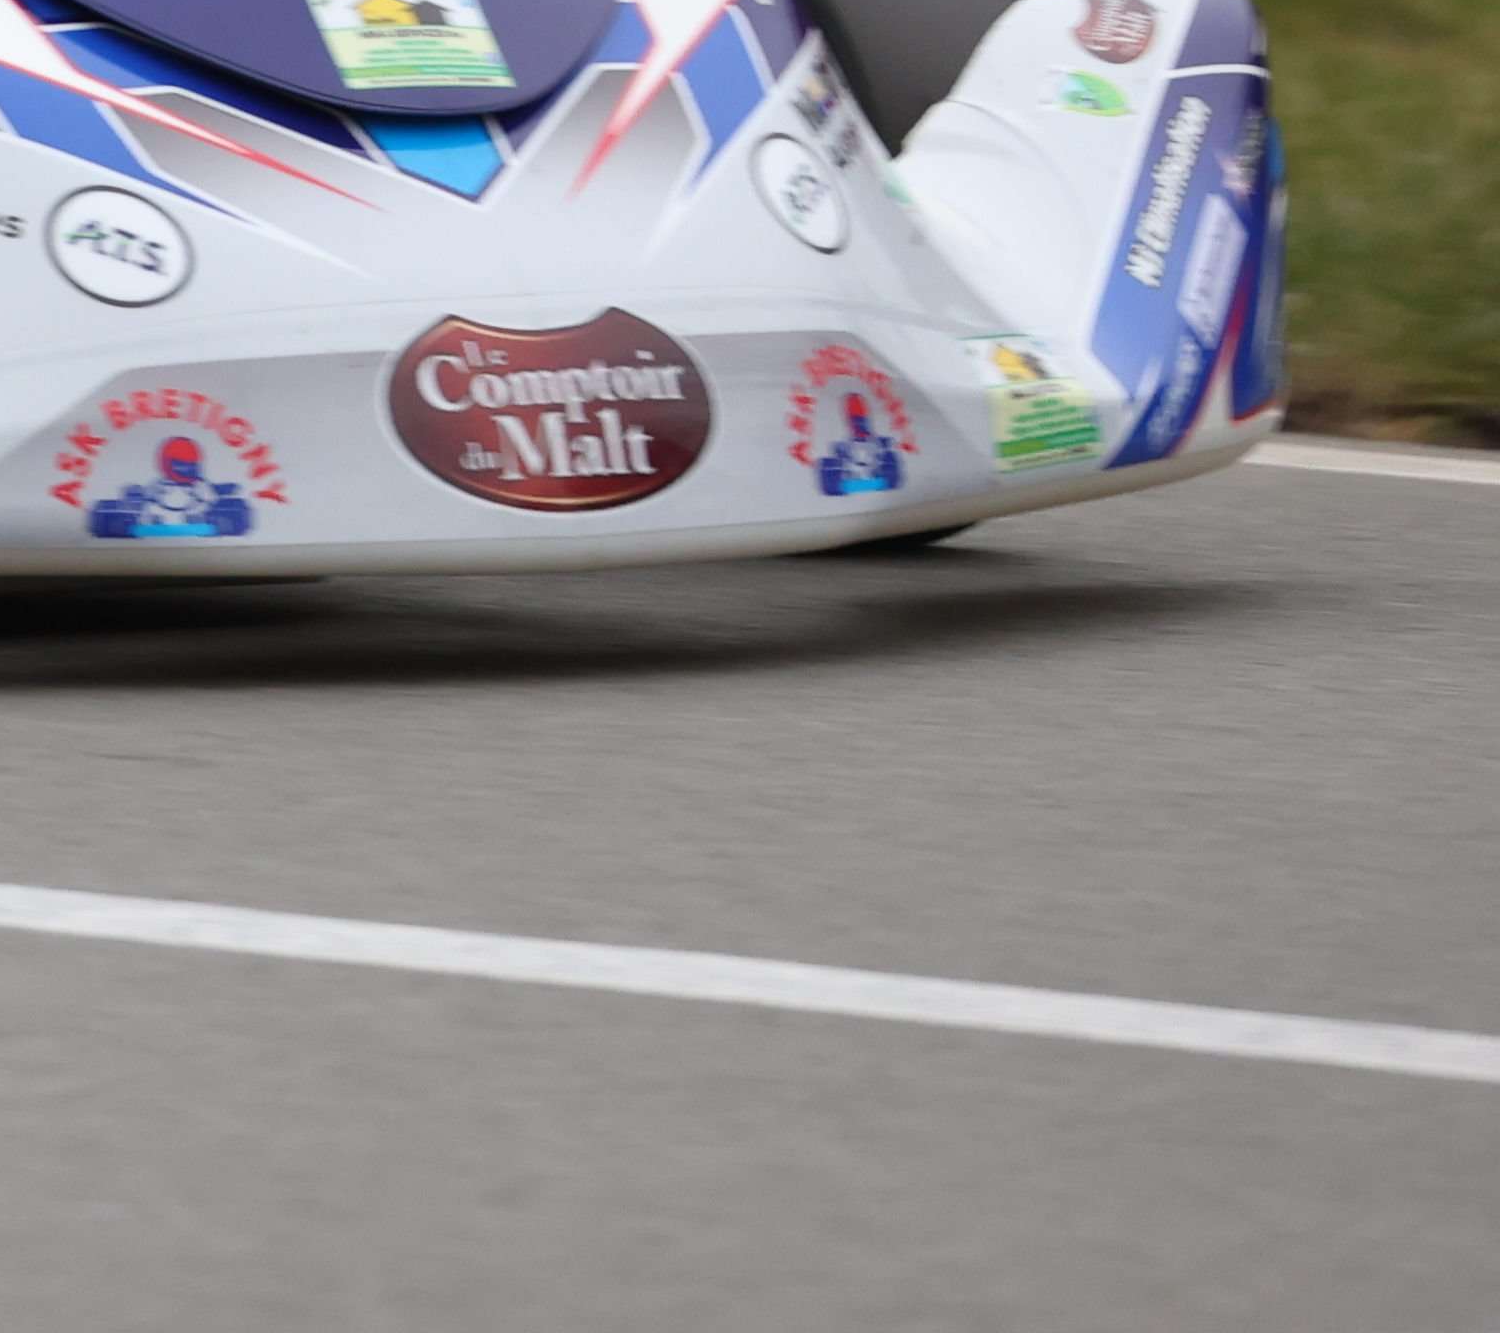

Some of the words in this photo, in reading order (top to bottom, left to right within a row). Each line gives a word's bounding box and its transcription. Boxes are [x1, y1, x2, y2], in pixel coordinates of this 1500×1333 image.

[414, 349, 686, 424] Comptoir
[48, 421, 111, 511] ASK
[101, 387, 293, 505] BRETIGNY
[489, 407, 659, 481] Malt
